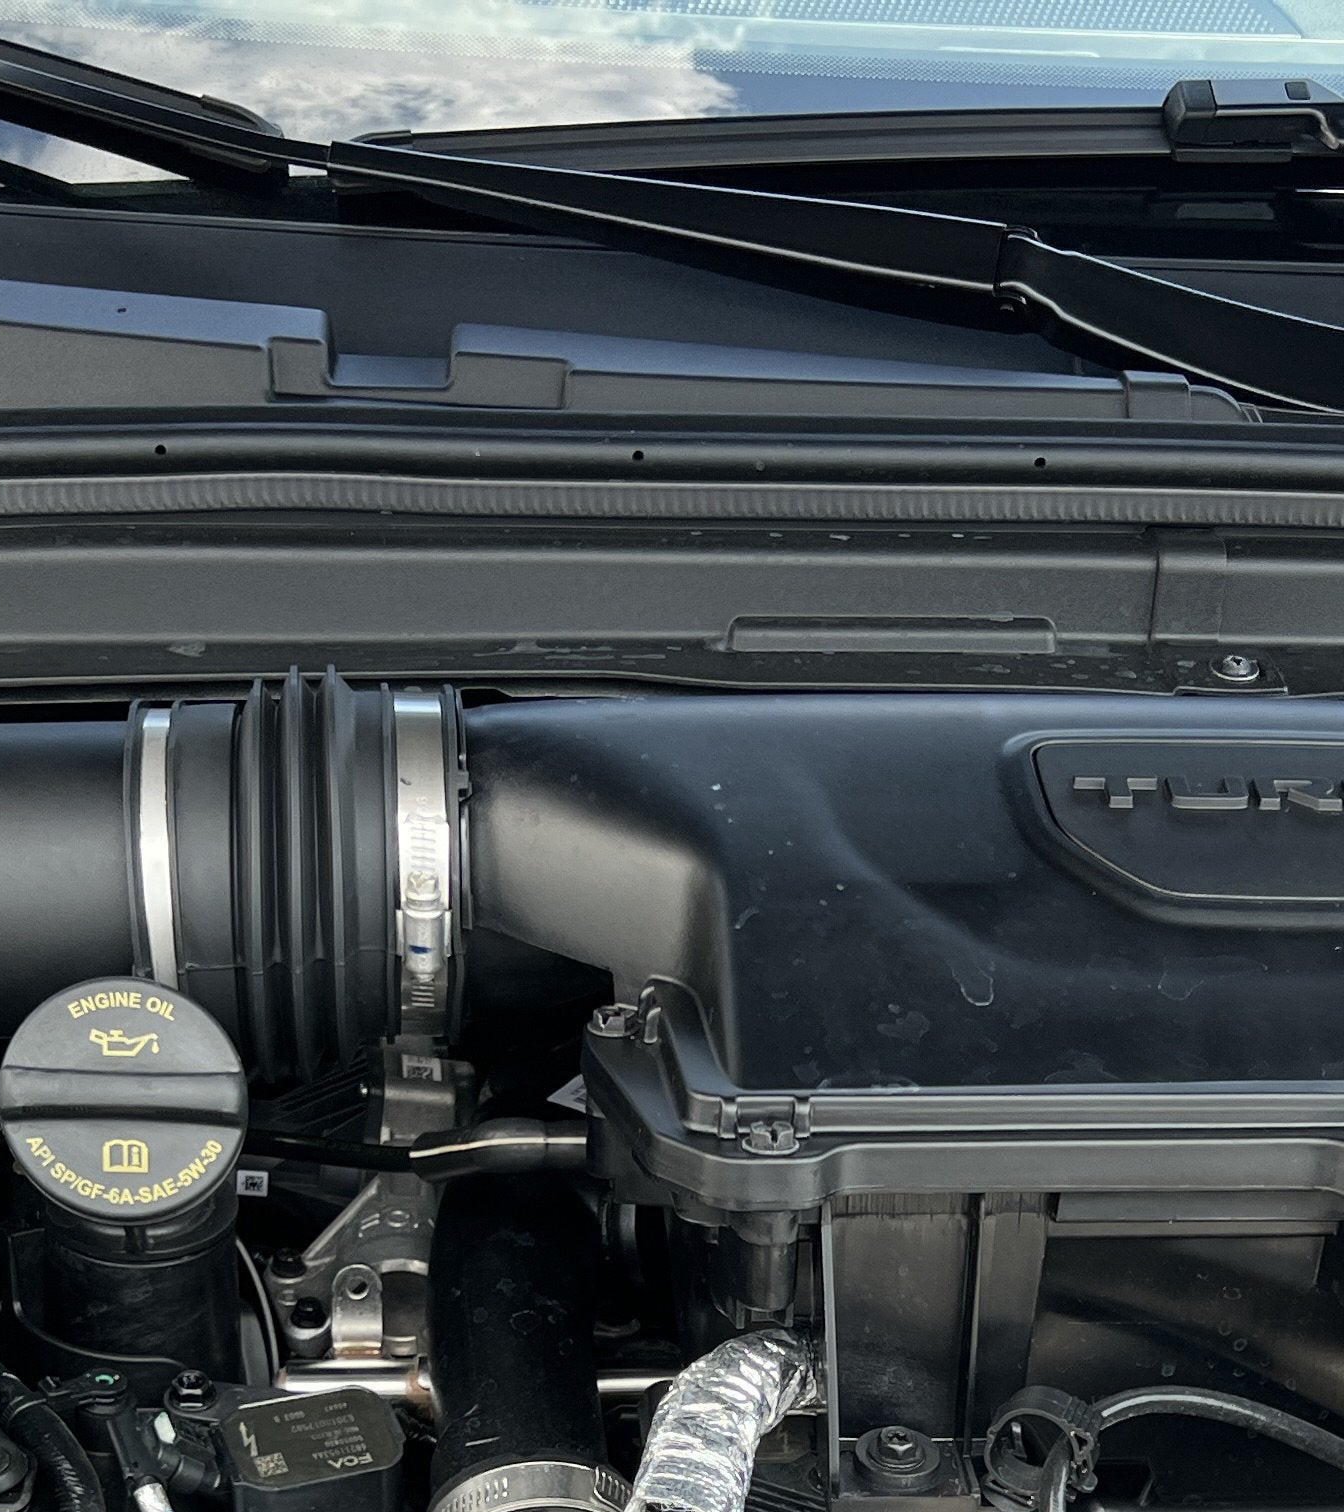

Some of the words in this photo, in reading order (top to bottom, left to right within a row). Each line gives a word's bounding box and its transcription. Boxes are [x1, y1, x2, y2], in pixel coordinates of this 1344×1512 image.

[67, 991, 142, 1020] ENGINE
[146, 997, 176, 1021] OIL
[26, 1135, 57, 1168] API
[50, 1139, 222, 1205] SP/GF-6A-SAE-5W-30
[327, 1452, 373, 1469] FCA
